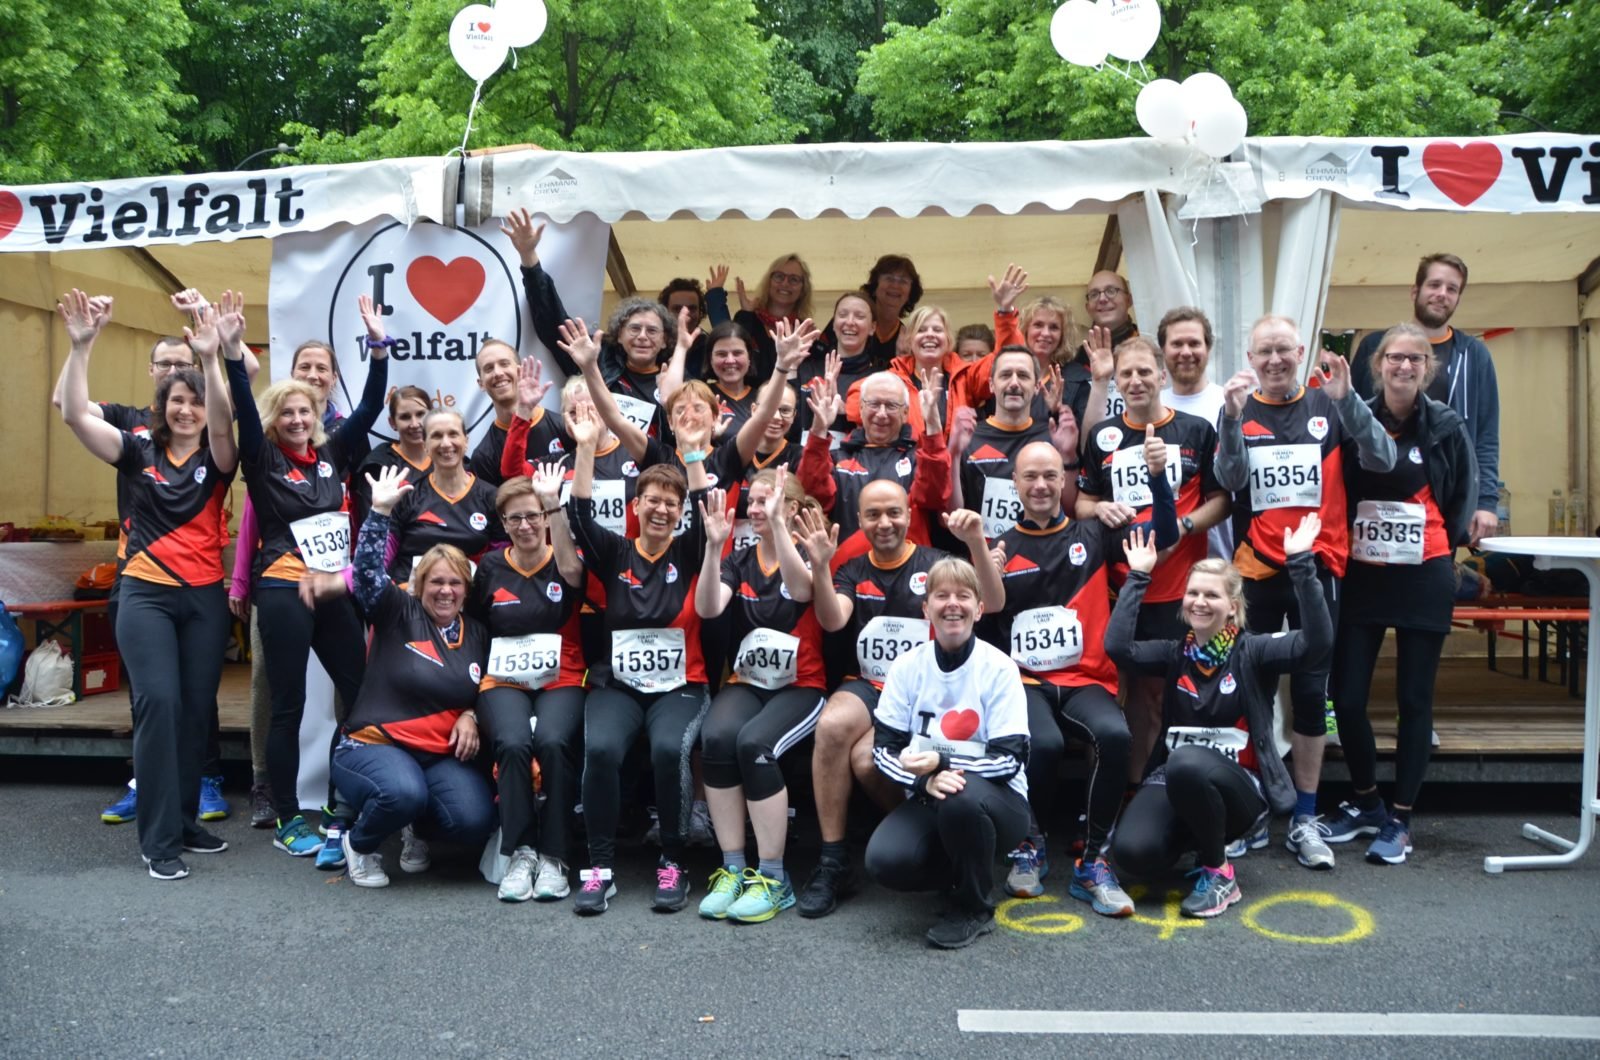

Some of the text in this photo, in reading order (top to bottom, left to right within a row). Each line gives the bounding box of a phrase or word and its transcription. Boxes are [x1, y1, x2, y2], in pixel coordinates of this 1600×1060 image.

[469, 22, 475, 32] I
[534, 180, 578, 189] LEHMANN
[1371, 145, 1411, 201] I
[29, 177, 304, 244] Vielfalt
[367, 262, 394, 316] I
[356, 331, 493, 362] Velfal
[1114, 463, 1177, 487] 1531
[1251, 465, 1320, 489] 15354
[1356, 520, 1422, 544] 15335
[859, 637, 924, 661] 1533
[1013, 625, 1078, 653] 15341
[492, 650, 558, 673] 15353
[615, 648, 683, 673] 15357
[738, 646, 795, 671] 15347
[917, 709, 936, 739] I
[932, 745, 956, 753] FIRMEN
